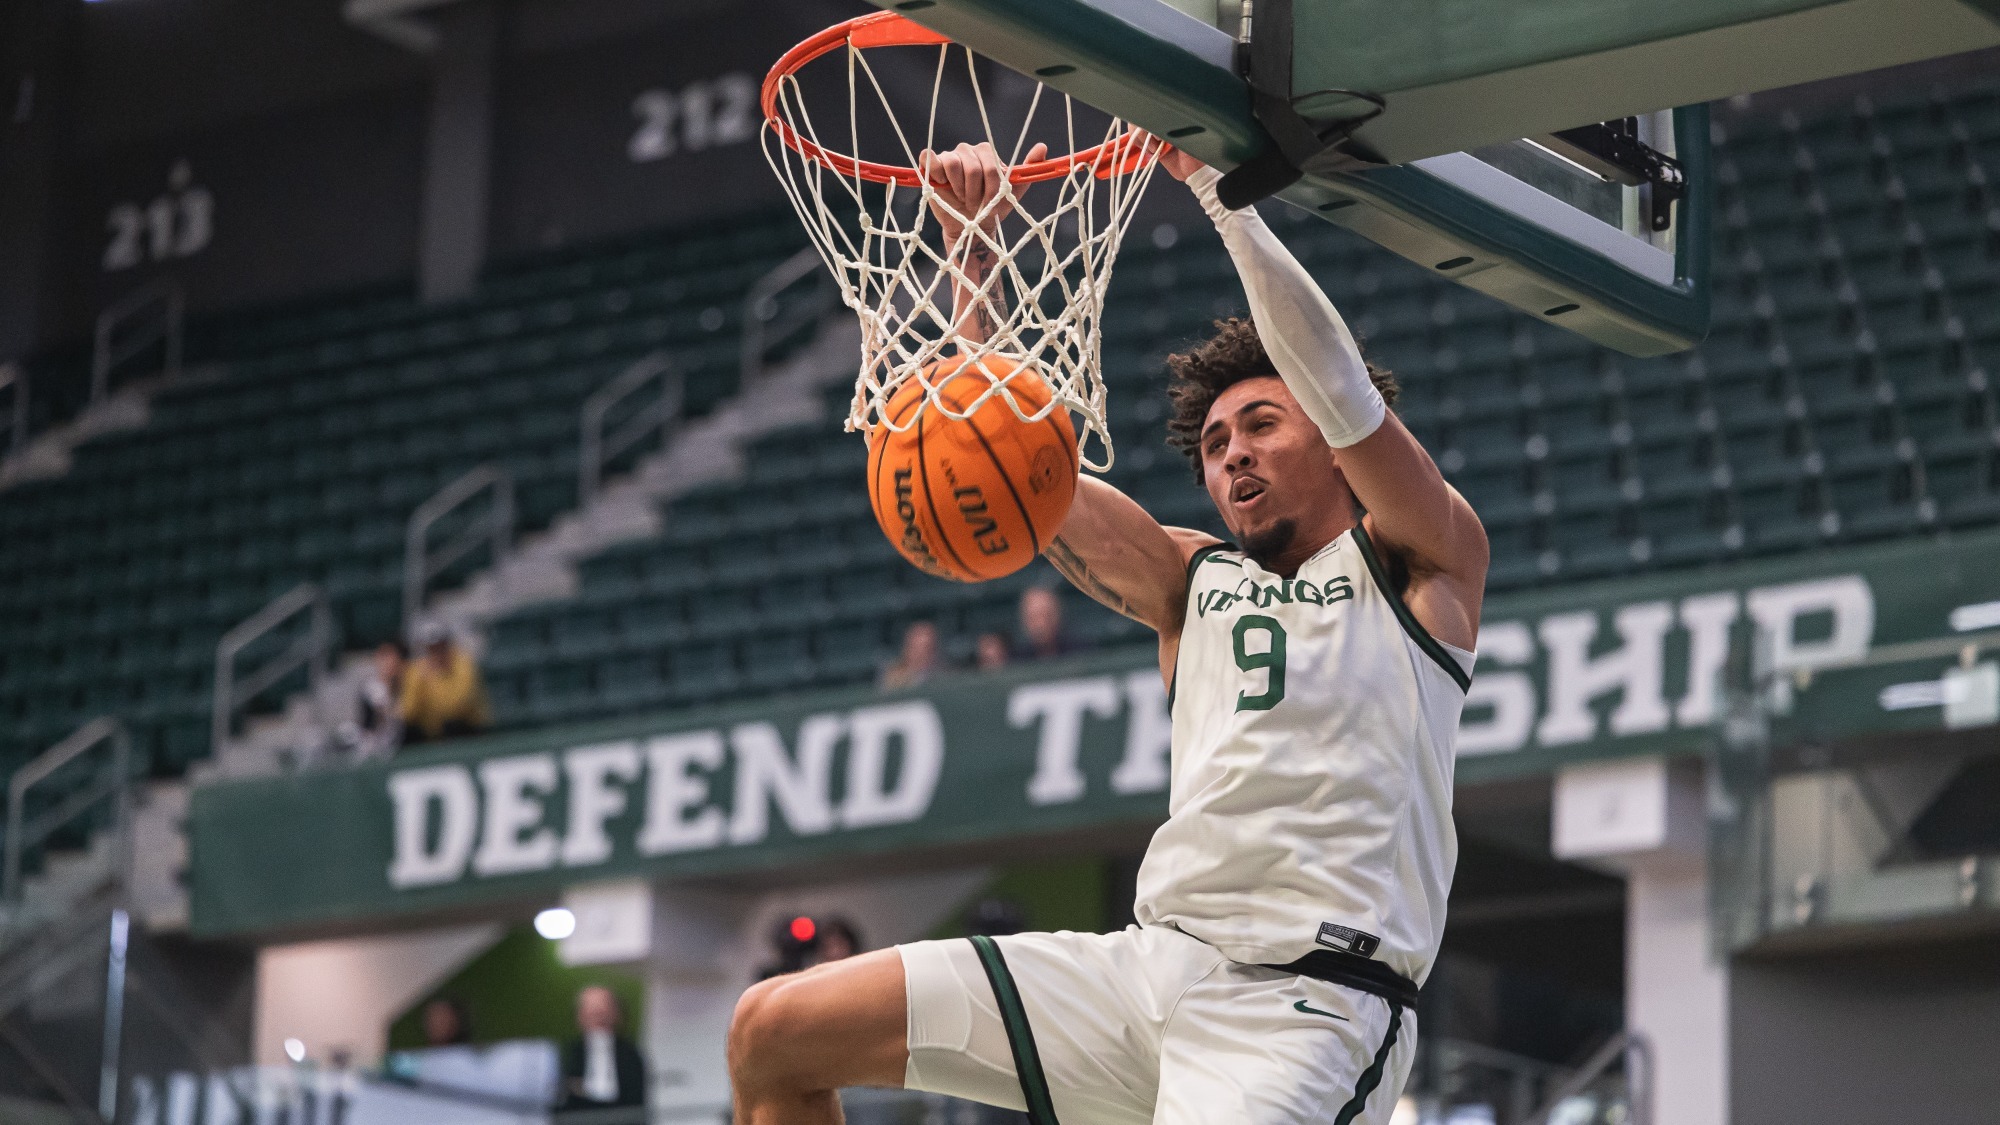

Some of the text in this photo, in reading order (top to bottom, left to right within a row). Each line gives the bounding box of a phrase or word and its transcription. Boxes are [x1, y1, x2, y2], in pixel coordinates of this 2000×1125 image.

[627, 74, 758, 161] 212
[103, 188, 213, 271] 213
[1198, 575, 1354, 619] VIKINGS
[1232, 614, 1287, 715] 9
[386, 701, 945, 888] DEFEND
[1358, 940, 1366, 952] L
